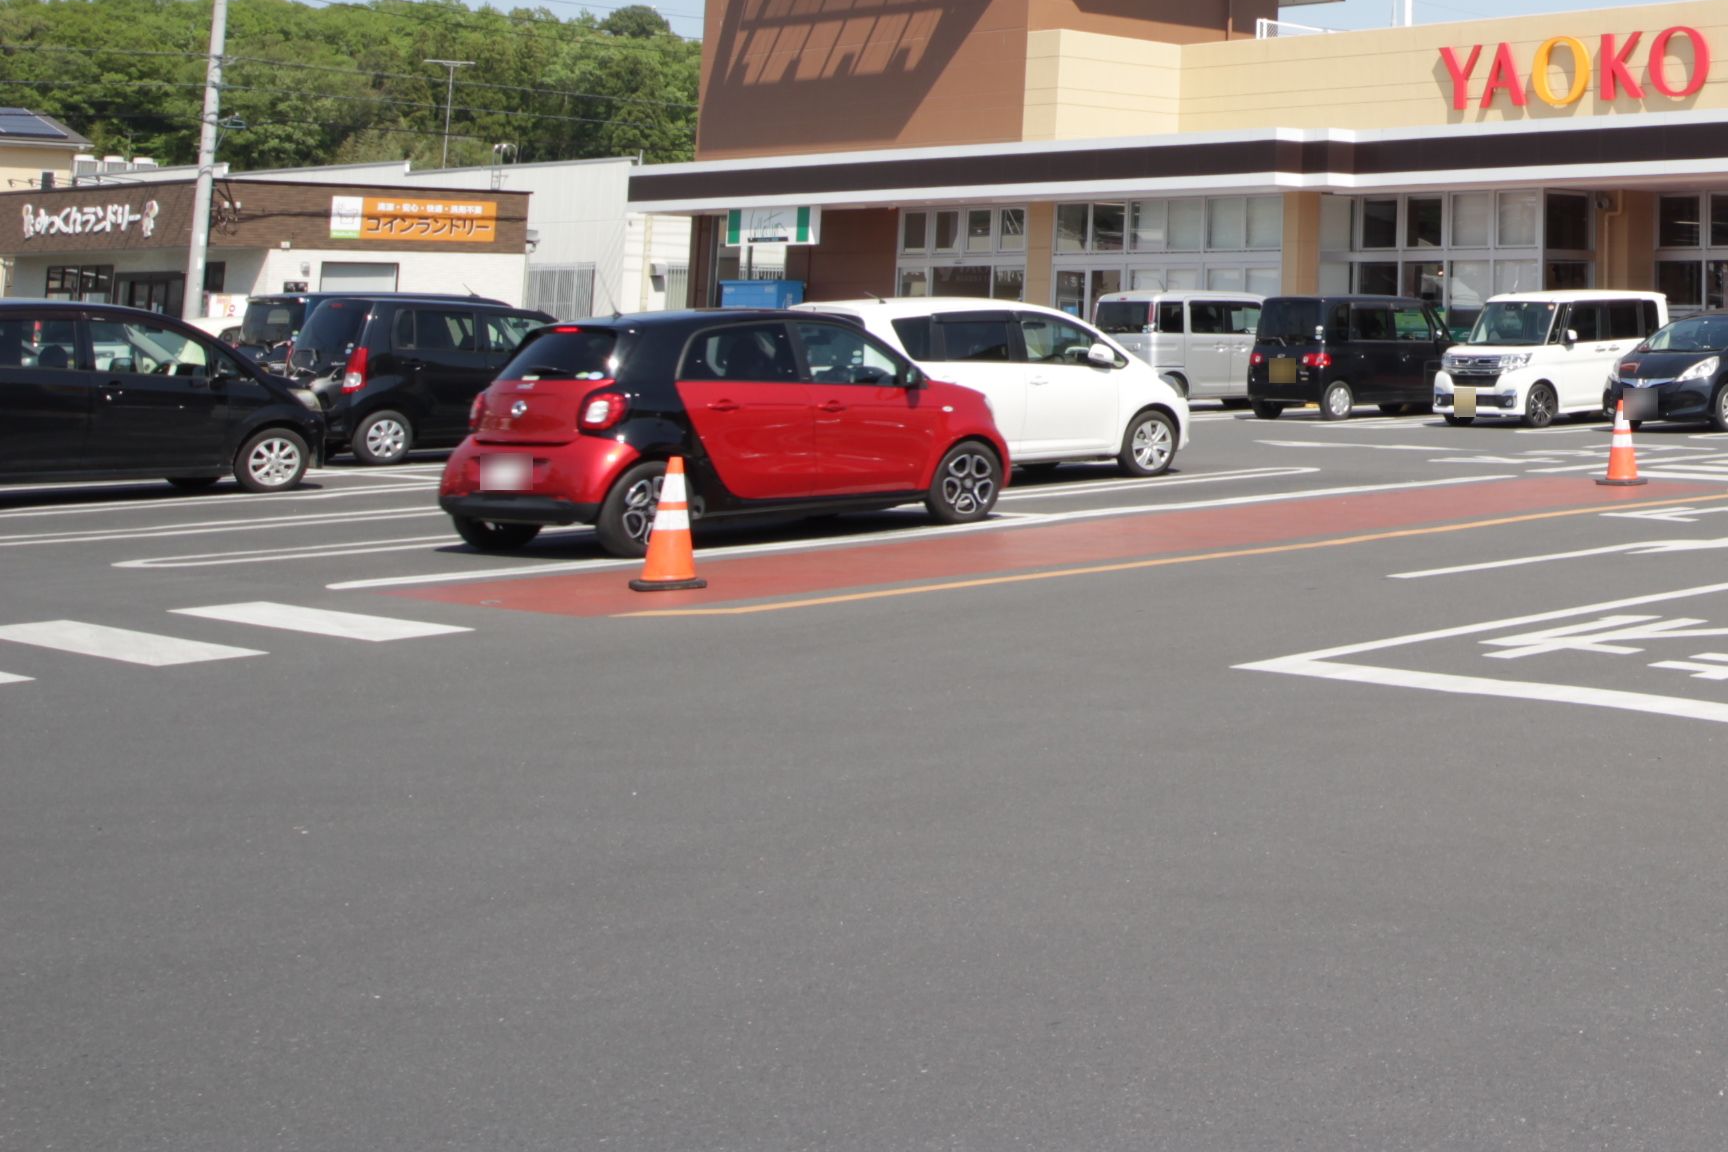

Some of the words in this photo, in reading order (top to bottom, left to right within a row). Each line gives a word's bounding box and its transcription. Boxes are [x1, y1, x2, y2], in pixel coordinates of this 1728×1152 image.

[1439, 26, 1711, 110] YAOKO
[366, 217, 490, 236] コインランドリー
